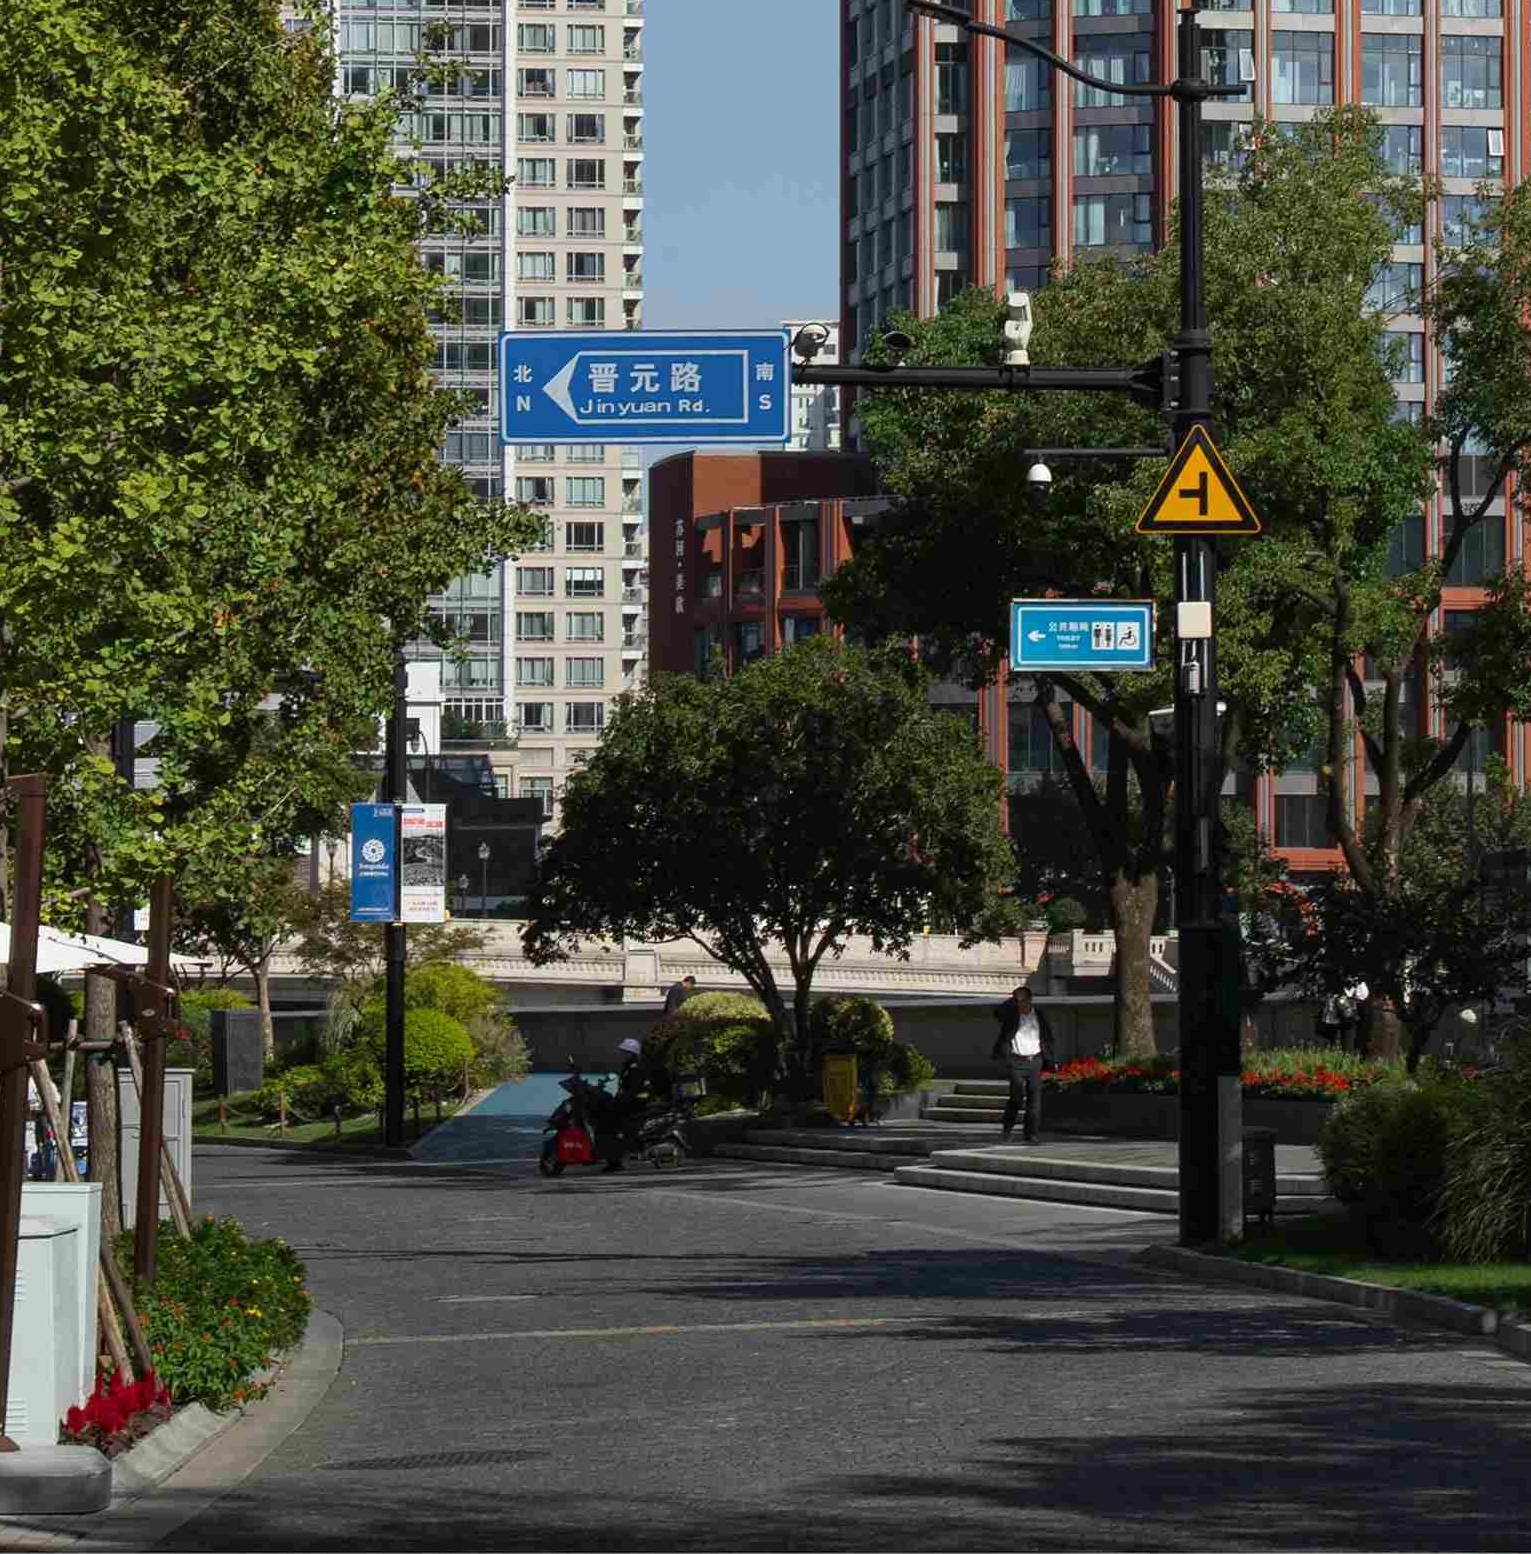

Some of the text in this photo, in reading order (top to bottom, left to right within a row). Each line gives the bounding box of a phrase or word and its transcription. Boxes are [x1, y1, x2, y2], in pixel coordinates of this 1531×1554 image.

[513, 364, 534, 384] 北
[588, 362, 702, 394] 晋元路
[755, 363, 775, 382] 南
[517, 396, 531, 412] N
[580, 398, 711, 417] Jinyuan Rd.
[758, 395, 773, 411] S
